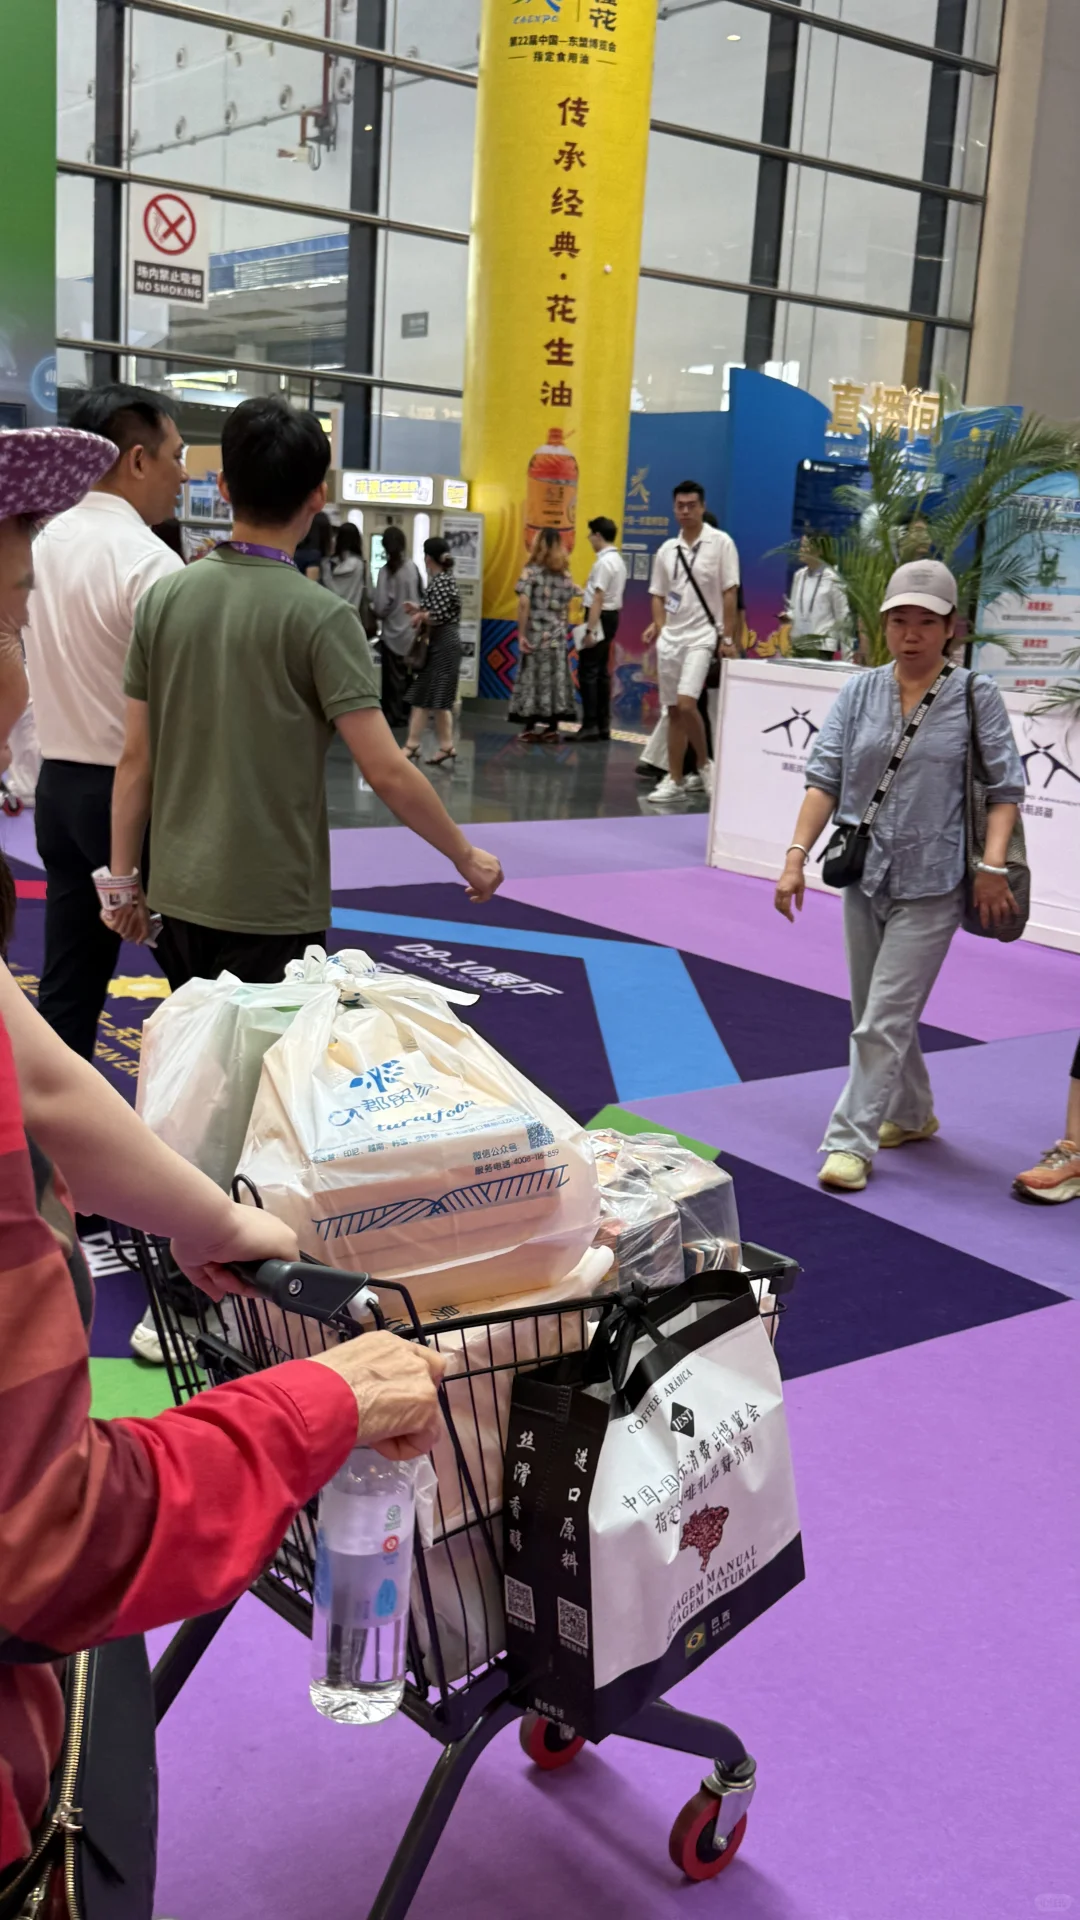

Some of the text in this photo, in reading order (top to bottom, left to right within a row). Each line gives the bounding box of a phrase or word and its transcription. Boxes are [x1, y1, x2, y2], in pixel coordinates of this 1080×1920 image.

[136, 281, 202, 299] NO SMOKING
[627, 1394, 662, 1434] COFFEE
[559, 1447, 590, 1577] 进口原料
[706, 1544, 758, 1585] MANUAL
[707, 1557, 758, 1600] NATURAL
[711, 1608, 731, 1630] 巴西
